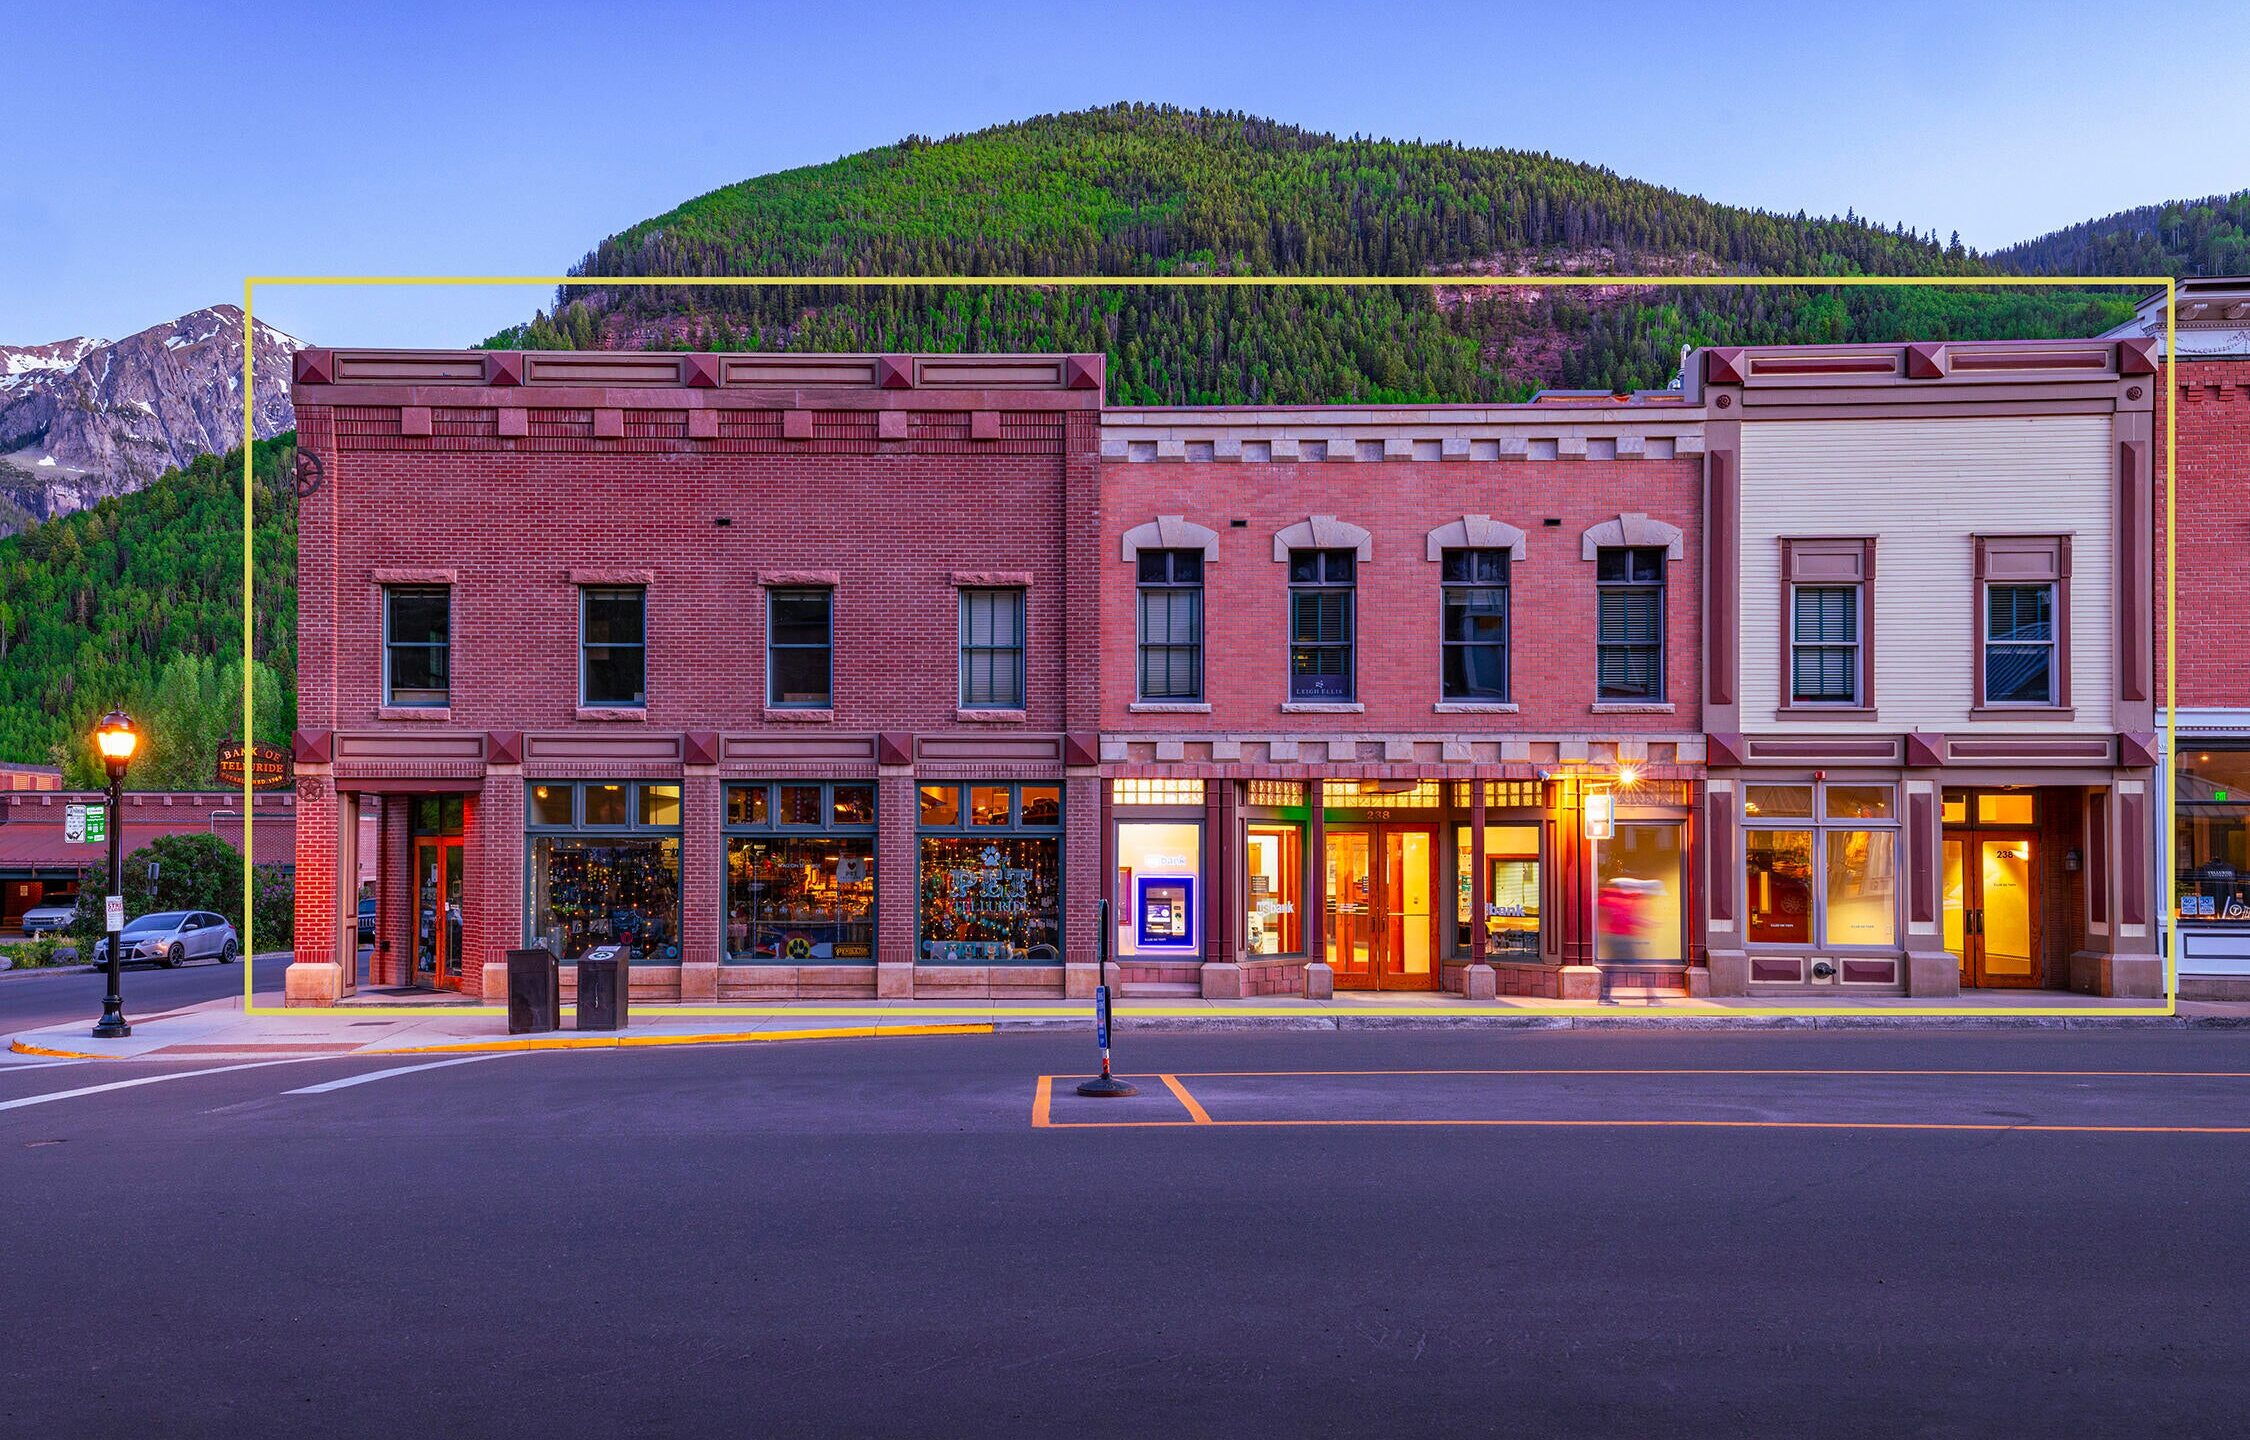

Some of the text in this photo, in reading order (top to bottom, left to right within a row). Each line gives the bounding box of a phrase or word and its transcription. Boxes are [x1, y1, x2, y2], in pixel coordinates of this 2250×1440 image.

[220, 761, 284, 774] TELRIDE
[220, 772, 266, 785] ESTABLHED
[1367, 810, 1390, 820] 238
[1996, 850, 2014, 859] 238
[950, 868, 1033, 898] PET
